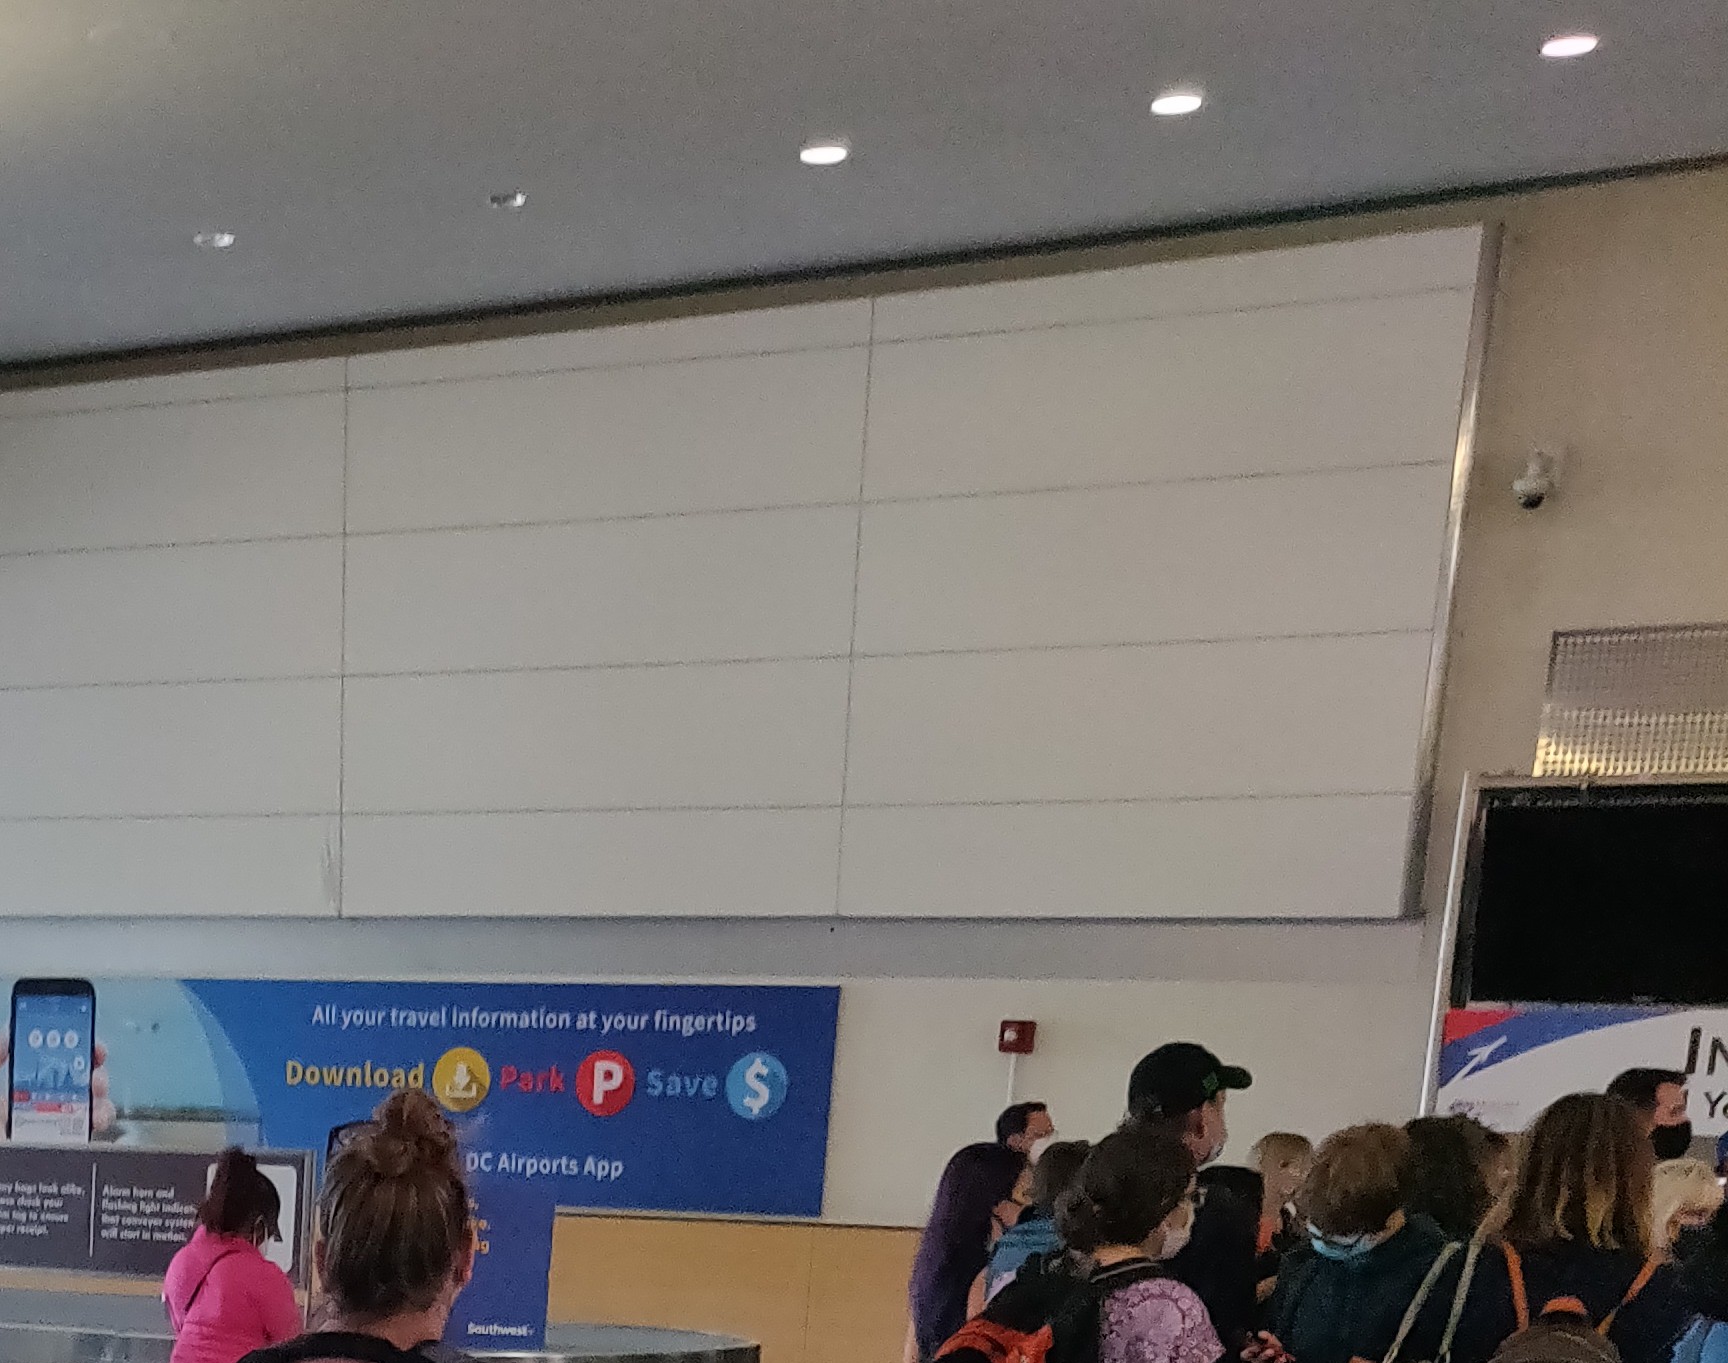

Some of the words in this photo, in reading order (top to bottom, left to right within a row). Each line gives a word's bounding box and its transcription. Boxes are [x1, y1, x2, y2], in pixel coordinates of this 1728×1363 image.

[311, 1003, 336, 1026] All
[340, 1007, 386, 1030] your
[390, 1005, 447, 1029] travel
[451, 1005, 570, 1030] information
[575, 1010, 597, 1030] at
[602, 1012, 649, 1037] your
[653, 1009, 757, 1037] fingertips
[285, 1059, 425, 1088] Download
[500, 1065, 565, 1093] Park
[592, 1059, 624, 1106] P
[646, 1067, 719, 1097] Save
[1704, 1090, 1728, 1118] Y
[465, 1151, 493, 1173] DC
[497, 1152, 579, 1178] Airports
[583, 1154, 624, 1182] App
[39, 1181, 59, 1195] look
[102, 1184, 131, 1198] Alarm
[133, 1185, 154, 1198] horn
[156, 1186, 175, 1199] and
[101, 1199, 138, 1214] flashing
[139, 1201, 161, 1214] light
